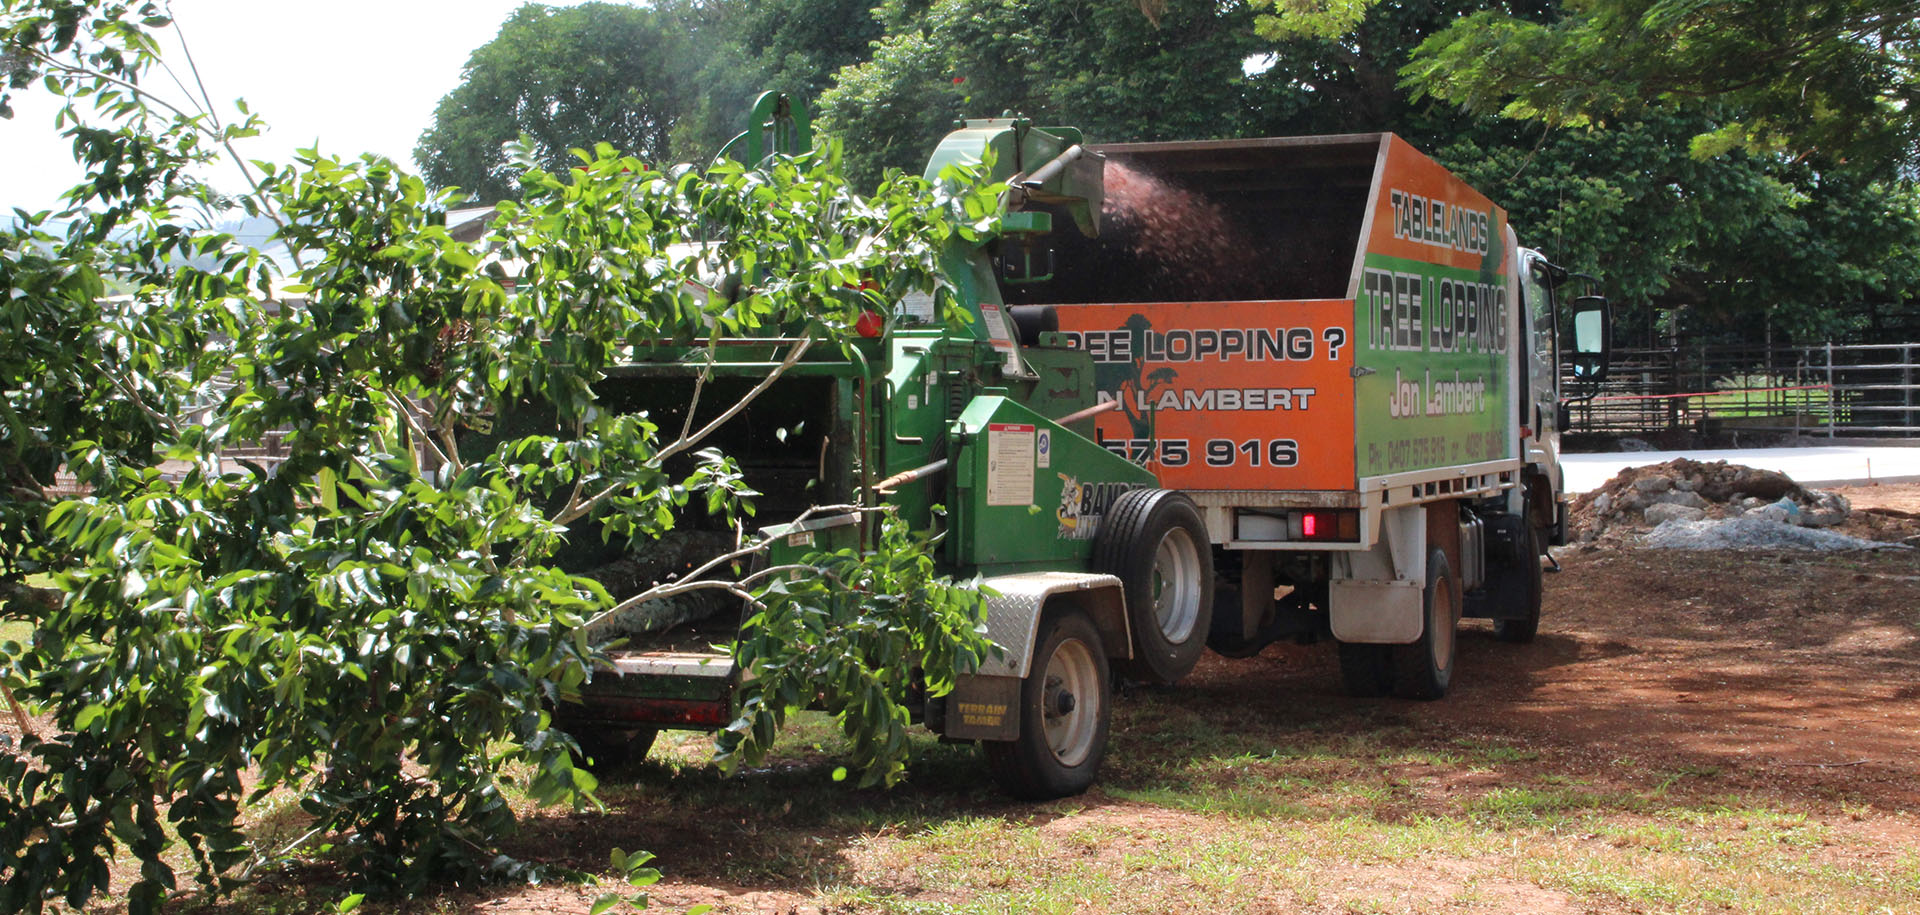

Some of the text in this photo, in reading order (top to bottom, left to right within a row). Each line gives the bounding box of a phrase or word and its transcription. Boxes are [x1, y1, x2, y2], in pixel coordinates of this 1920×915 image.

[1390, 188, 1489, 257] TABLELANDS
[1364, 267, 1508, 355] TREE LOPPING
[1144, 327, 1315, 363] LOPPING
[1322, 326, 1346, 361] ?
[1137, 387, 1316, 412] LAMBERT
[1389, 366, 1486, 419] Jon Lambert
[1205, 438, 1300, 468] 916
[1387, 439, 1411, 470] 0407
[959, 703, 1007, 714] TERRAIN
